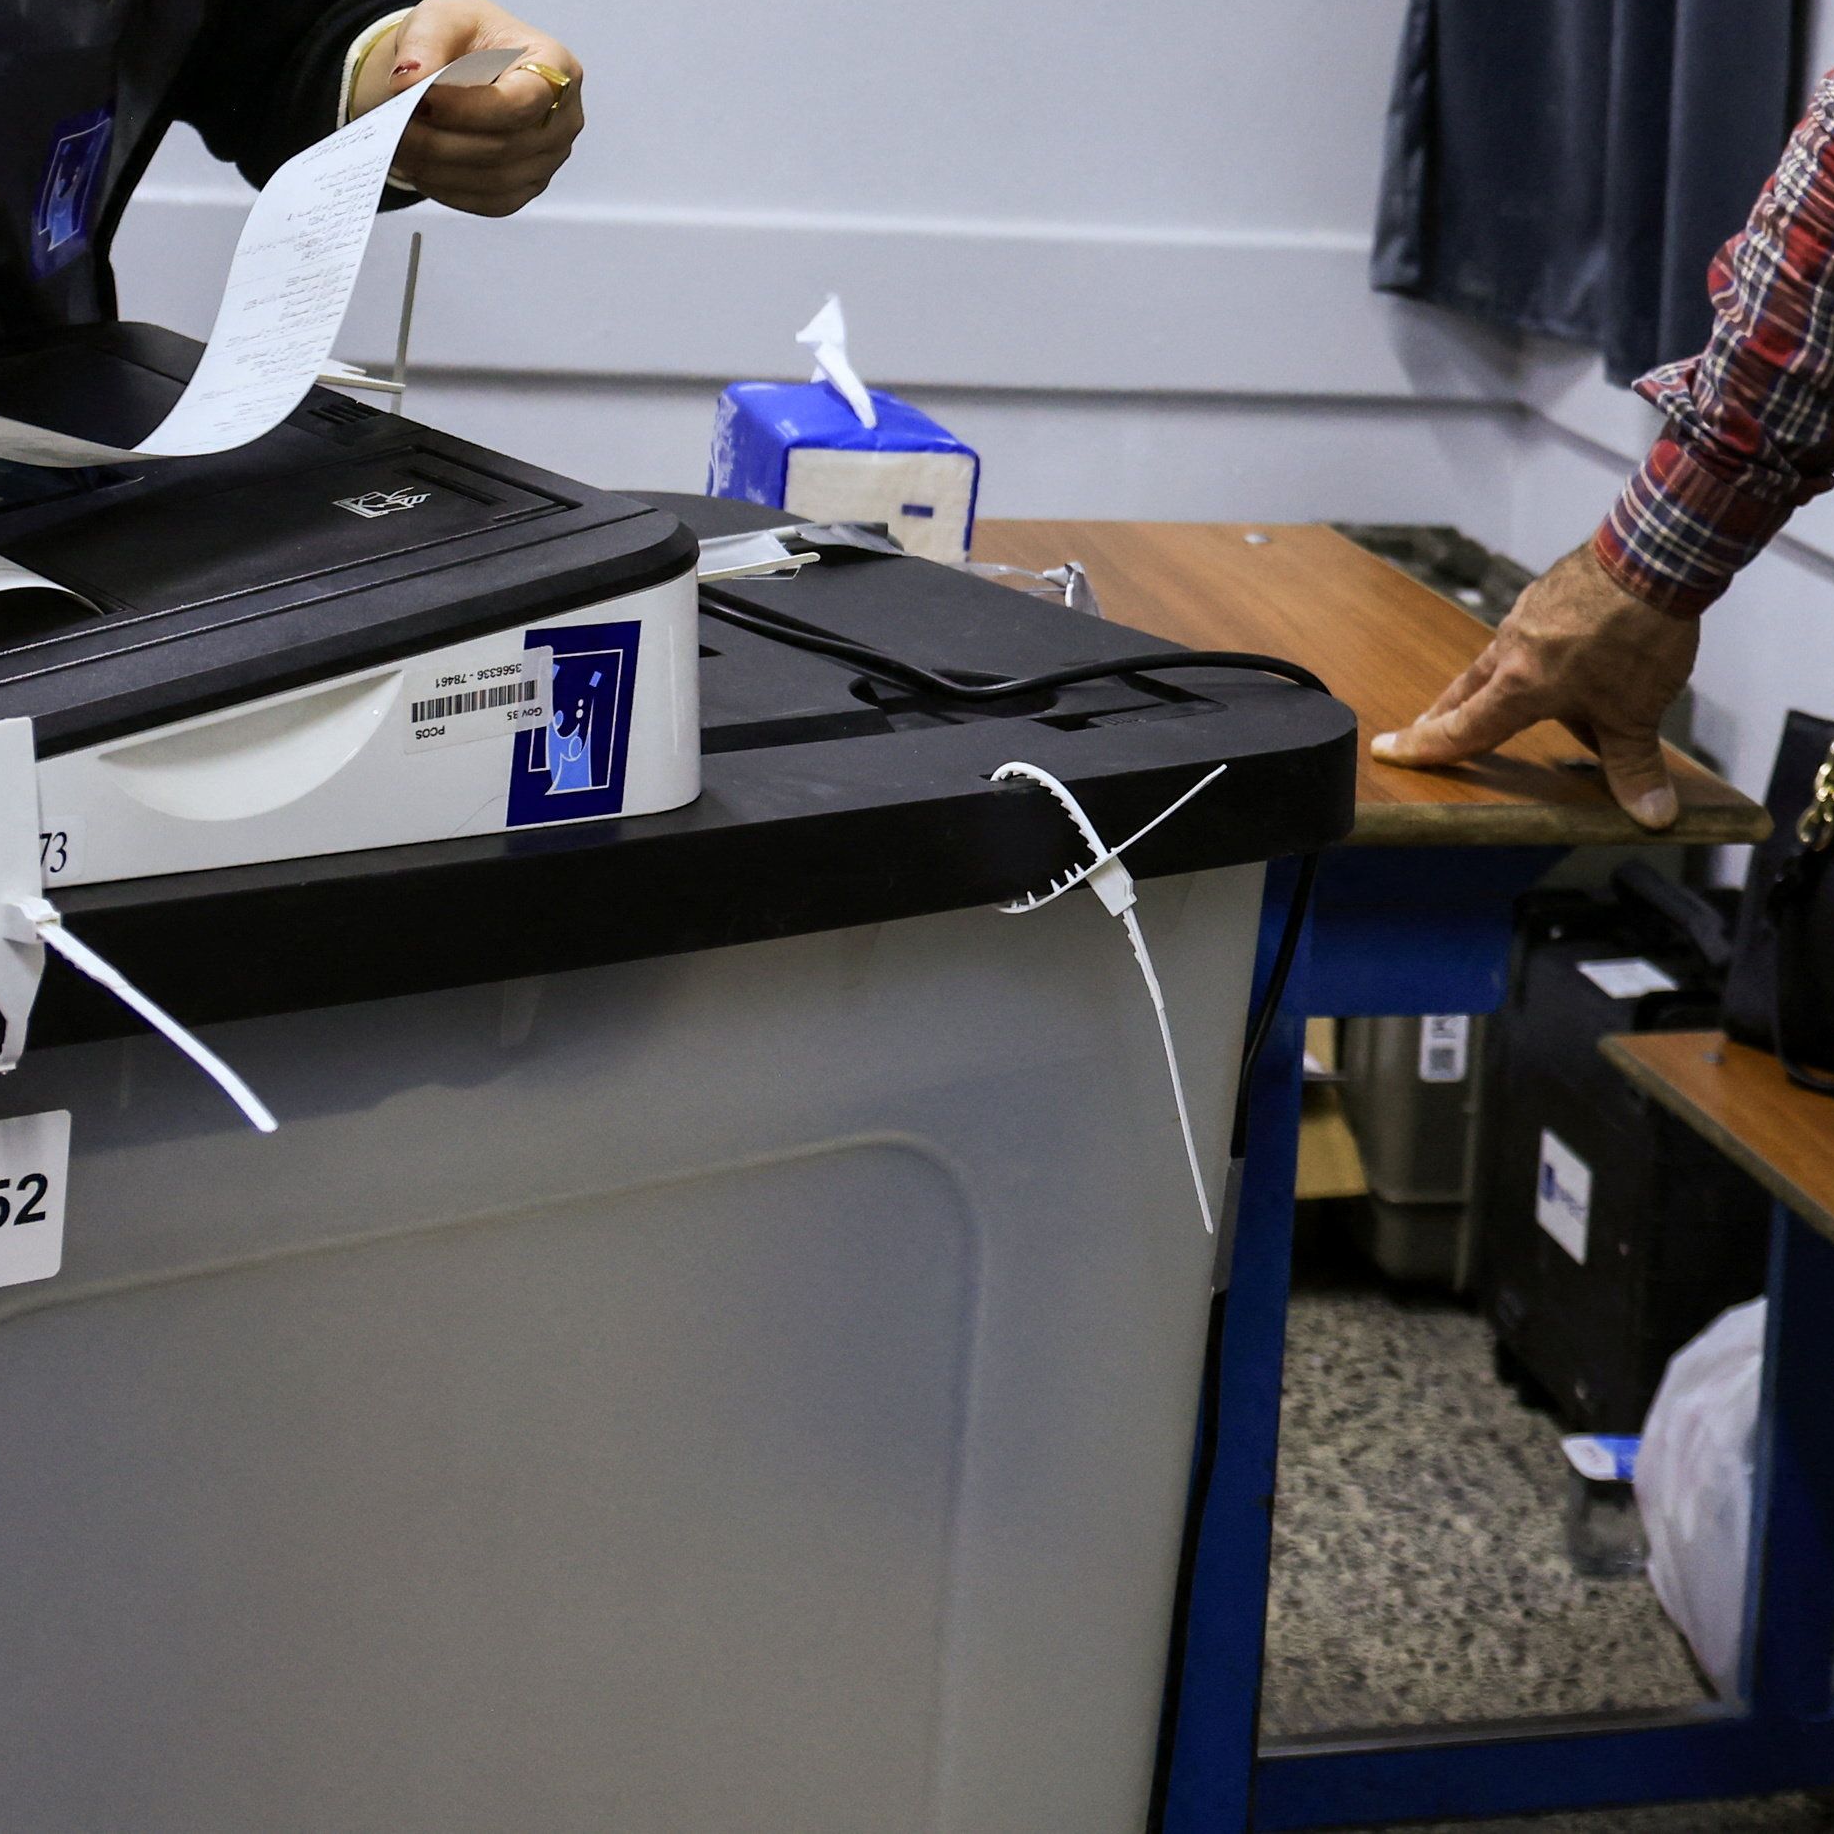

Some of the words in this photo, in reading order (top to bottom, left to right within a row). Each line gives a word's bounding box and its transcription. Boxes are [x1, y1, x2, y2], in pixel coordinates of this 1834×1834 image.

[477, 663, 522, 680] 3566336
[435, 673, 467, 688] 78461
[507, 710, 519, 721] 35
[521, 706, 542, 717] Gov
[415, 725, 445, 740] PCOS
